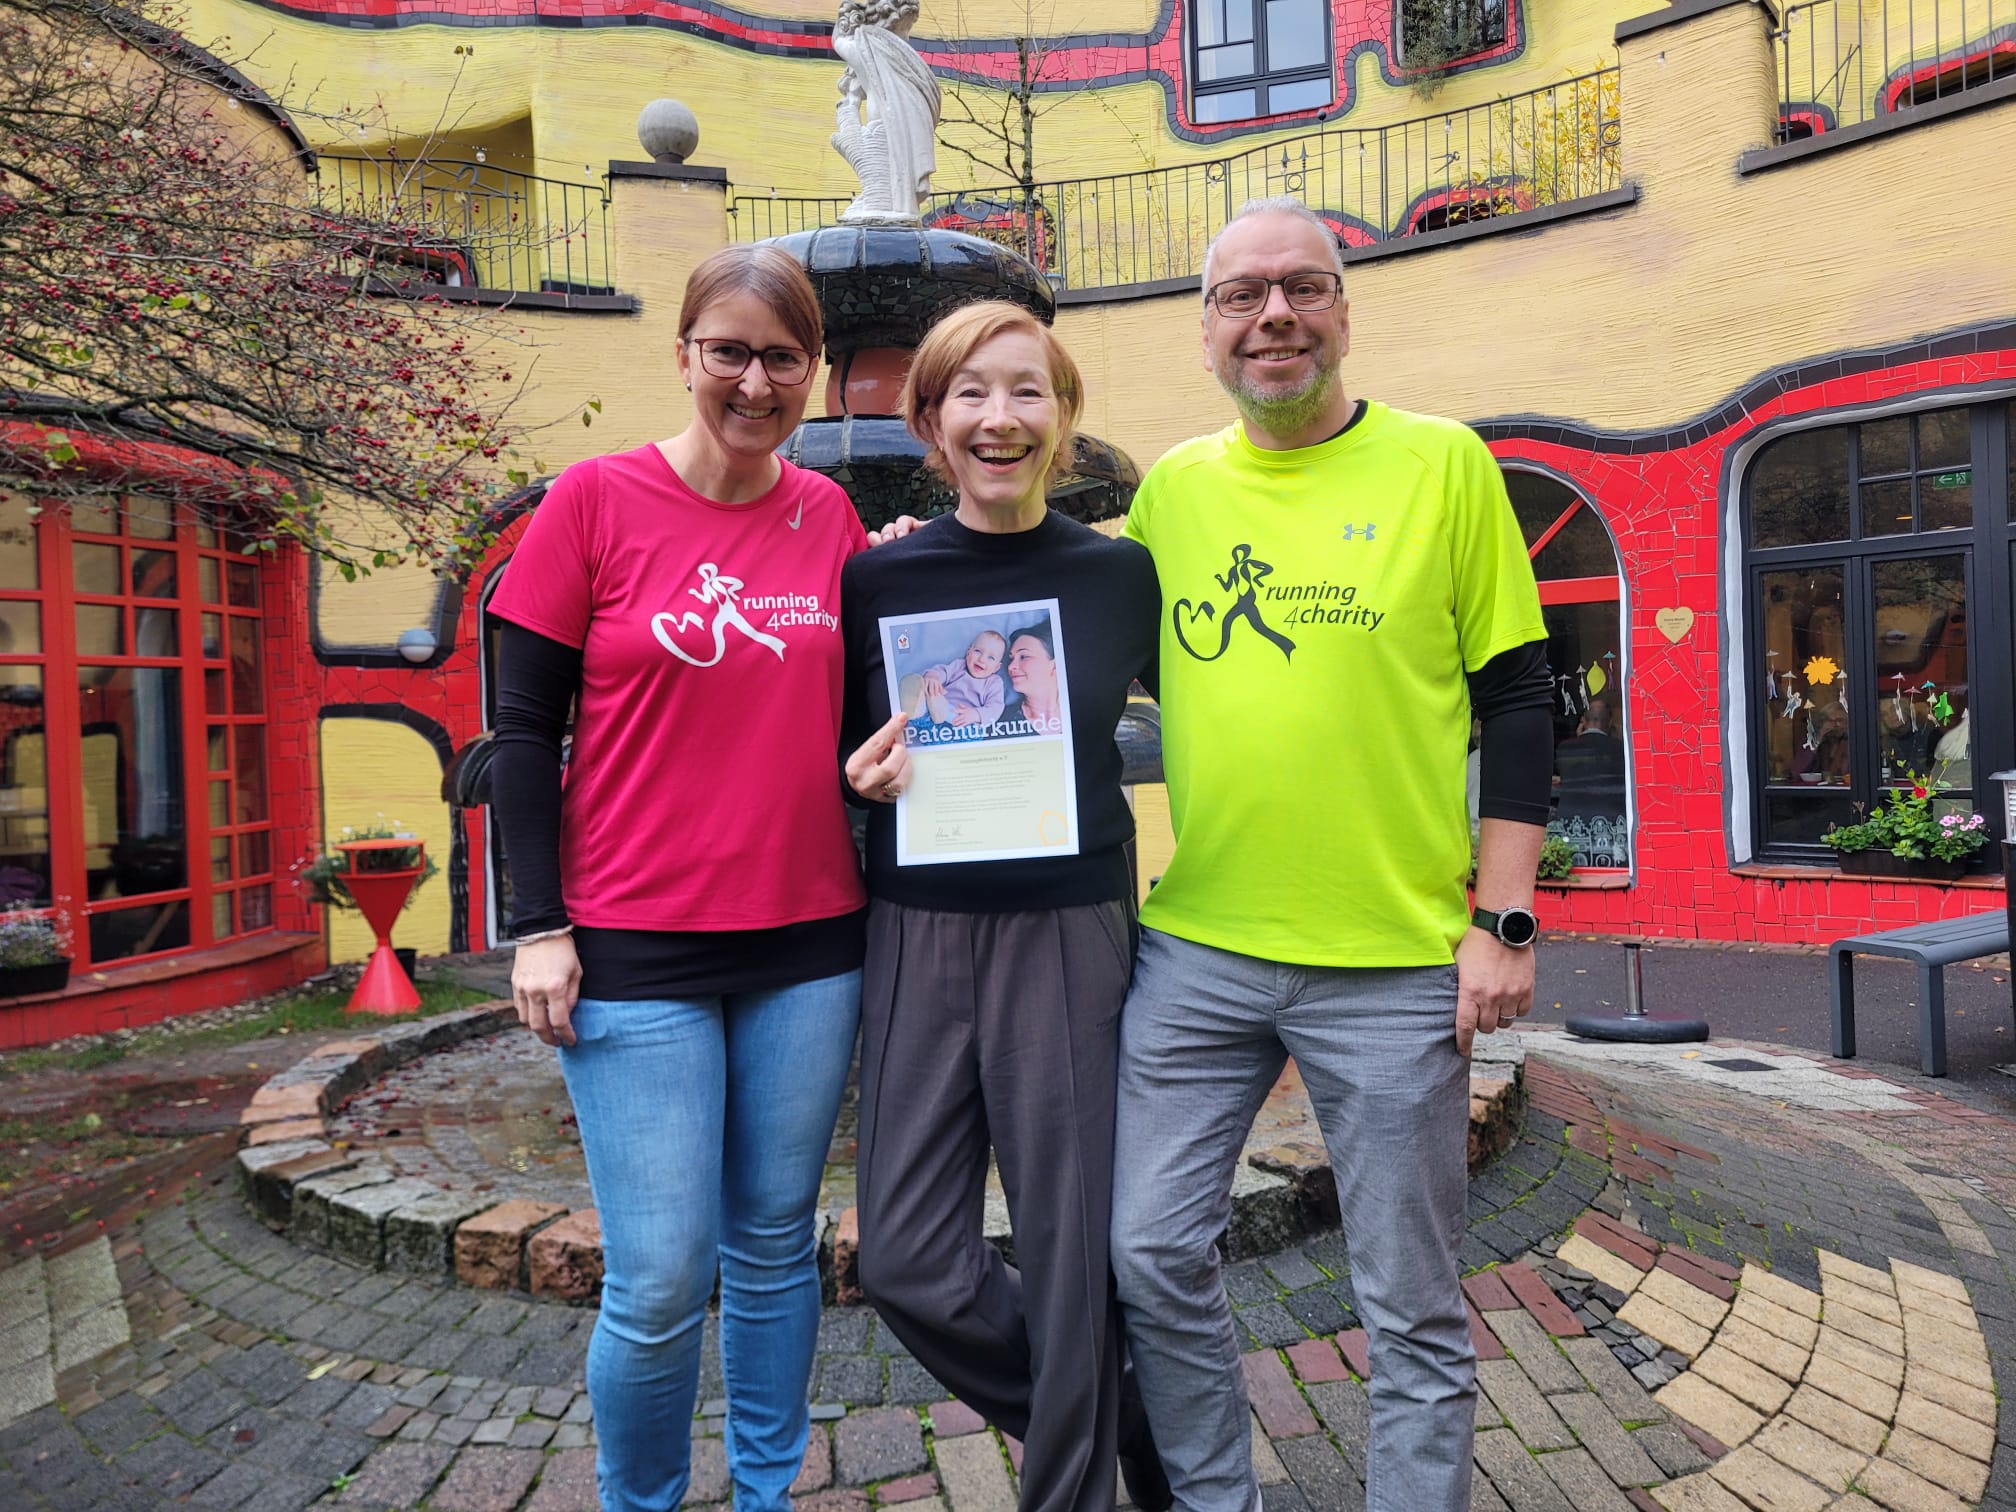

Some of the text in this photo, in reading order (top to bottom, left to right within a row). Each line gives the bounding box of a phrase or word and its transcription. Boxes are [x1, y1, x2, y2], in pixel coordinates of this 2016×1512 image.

[743, 592, 819, 612] running
[1266, 581, 1357, 606] running
[766, 609, 839, 632] 4charity
[1283, 602, 1385, 632] 4charity
[904, 714, 1062, 745] Patenurkunde
